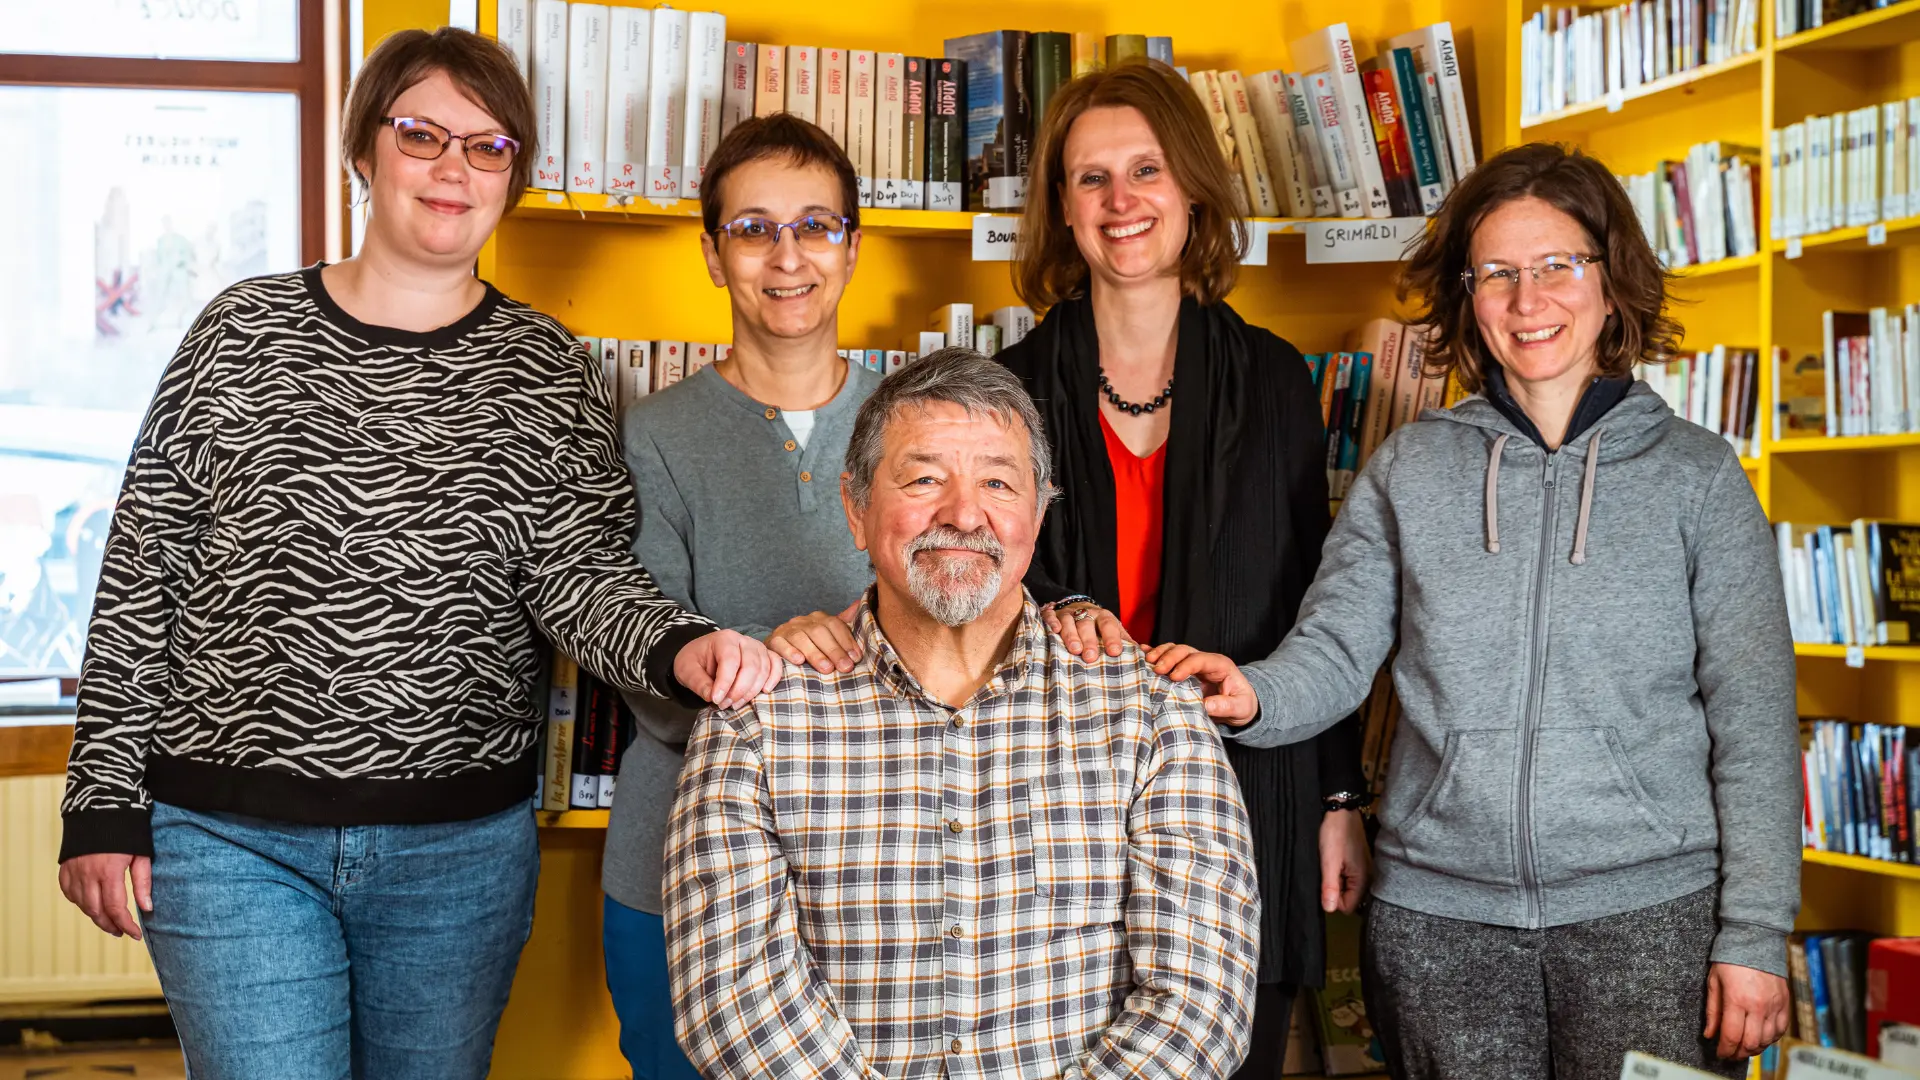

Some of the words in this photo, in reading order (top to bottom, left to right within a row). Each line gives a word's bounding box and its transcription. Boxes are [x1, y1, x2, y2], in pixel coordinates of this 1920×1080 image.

[1340, 39, 1355, 73] DUPUY
[1440, 39, 1457, 77] DUPUY
[738, 63, 747, 90] DUPUY
[768, 66, 779, 93] DUPUY
[801, 69, 810, 95] DUPUY
[832, 69, 841, 95] DUPUY
[908, 80, 921, 115] DUPUY
[943, 80, 956, 115] DUPUY
[1378, 92, 1396, 124] DUPUY
[1292, 95, 1310, 126] DUPUY
[1321, 95, 1340, 127] DUPUY
[547, 156, 555, 167] R
[583, 163, 591, 172] R
[623, 164, 633, 176] R
[539, 170, 560, 183] Dup
[574, 176, 595, 188] Dup
[612, 178, 636, 190] Dup
[654, 180, 677, 192] Dup
[663, 168, 671, 180] R
[861, 192, 871, 203] up
[876, 190, 897, 203] Dup
[933, 194, 954, 206] Dup
[1324, 225, 1397, 248] GRIMALDI
[1383, 332, 1397, 379] GRIMALDI
